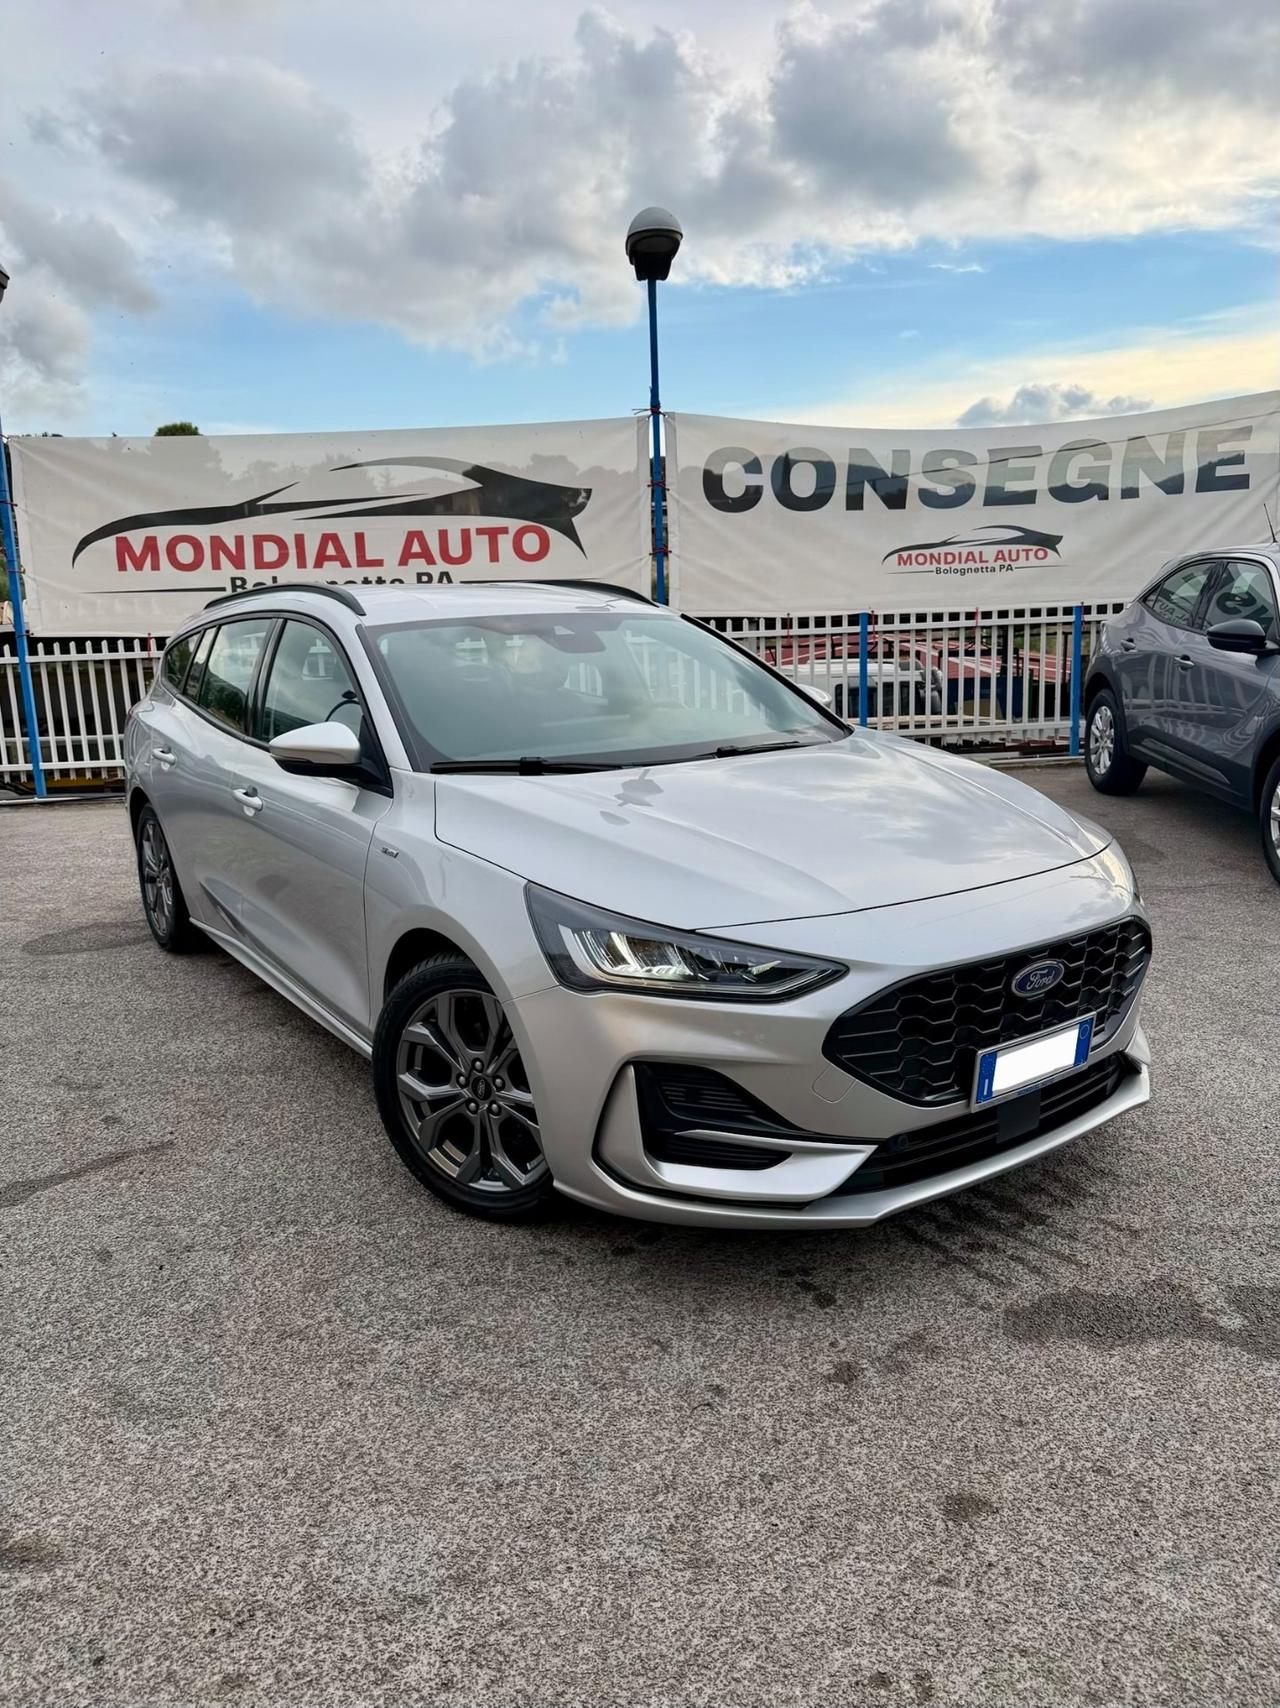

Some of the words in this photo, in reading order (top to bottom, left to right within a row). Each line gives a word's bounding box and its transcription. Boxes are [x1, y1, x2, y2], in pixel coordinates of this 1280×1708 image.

[702, 425, 1253, 513] CONSEGNE
[115, 531, 385, 572] MONDIAL
[397, 524, 551, 567] AUTO
[897, 551, 989, 566] MONDIAL
[994, 548, 1049, 562] AUTO
[935, 565, 996, 576] Bolognetta
[999, 564, 1014, 573] PA
[1026, 969, 1055, 990] Ford
